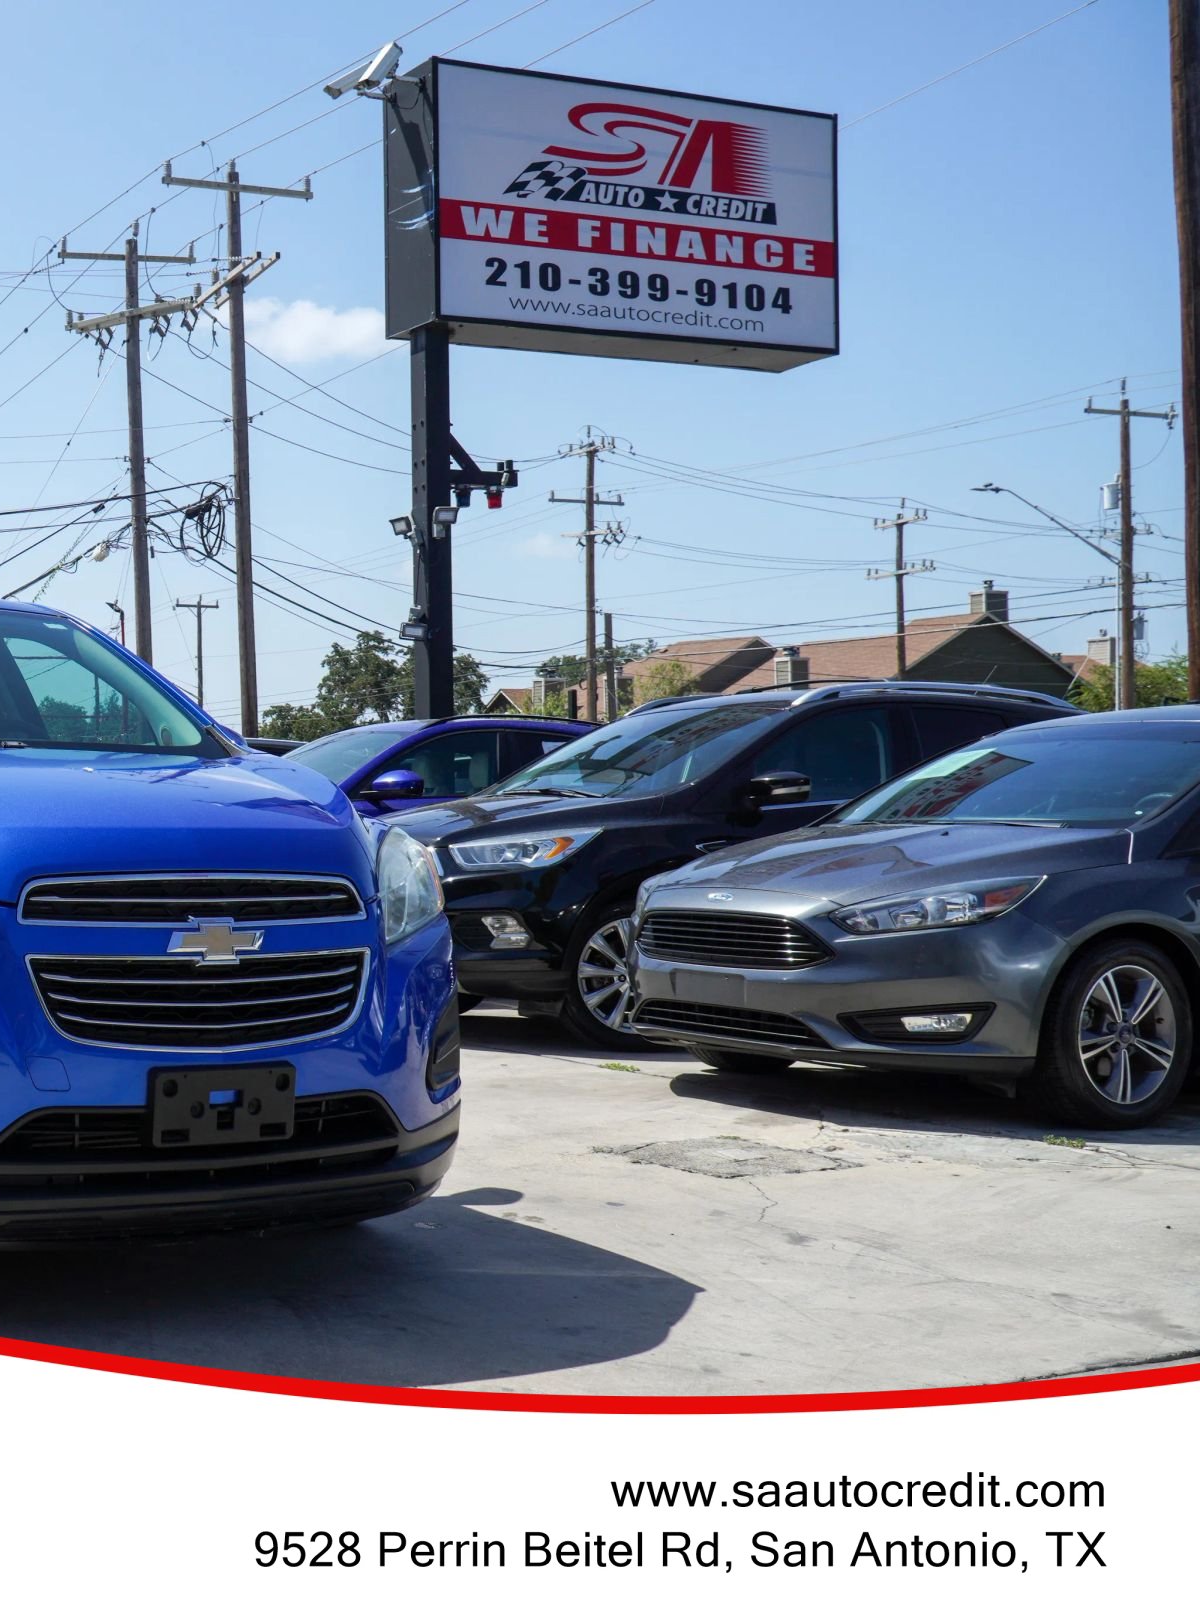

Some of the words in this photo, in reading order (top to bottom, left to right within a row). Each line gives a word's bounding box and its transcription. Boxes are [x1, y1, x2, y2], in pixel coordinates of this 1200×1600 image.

[580, 180, 645, 208] AUTO
[686, 193, 768, 223] CREDIT
[460, 205, 550, 243] WE
[577, 218, 816, 272] FINANCE
[485, 257, 793, 314] 210-399-9104
[509, 295, 764, 332] www.saautocredit.com
